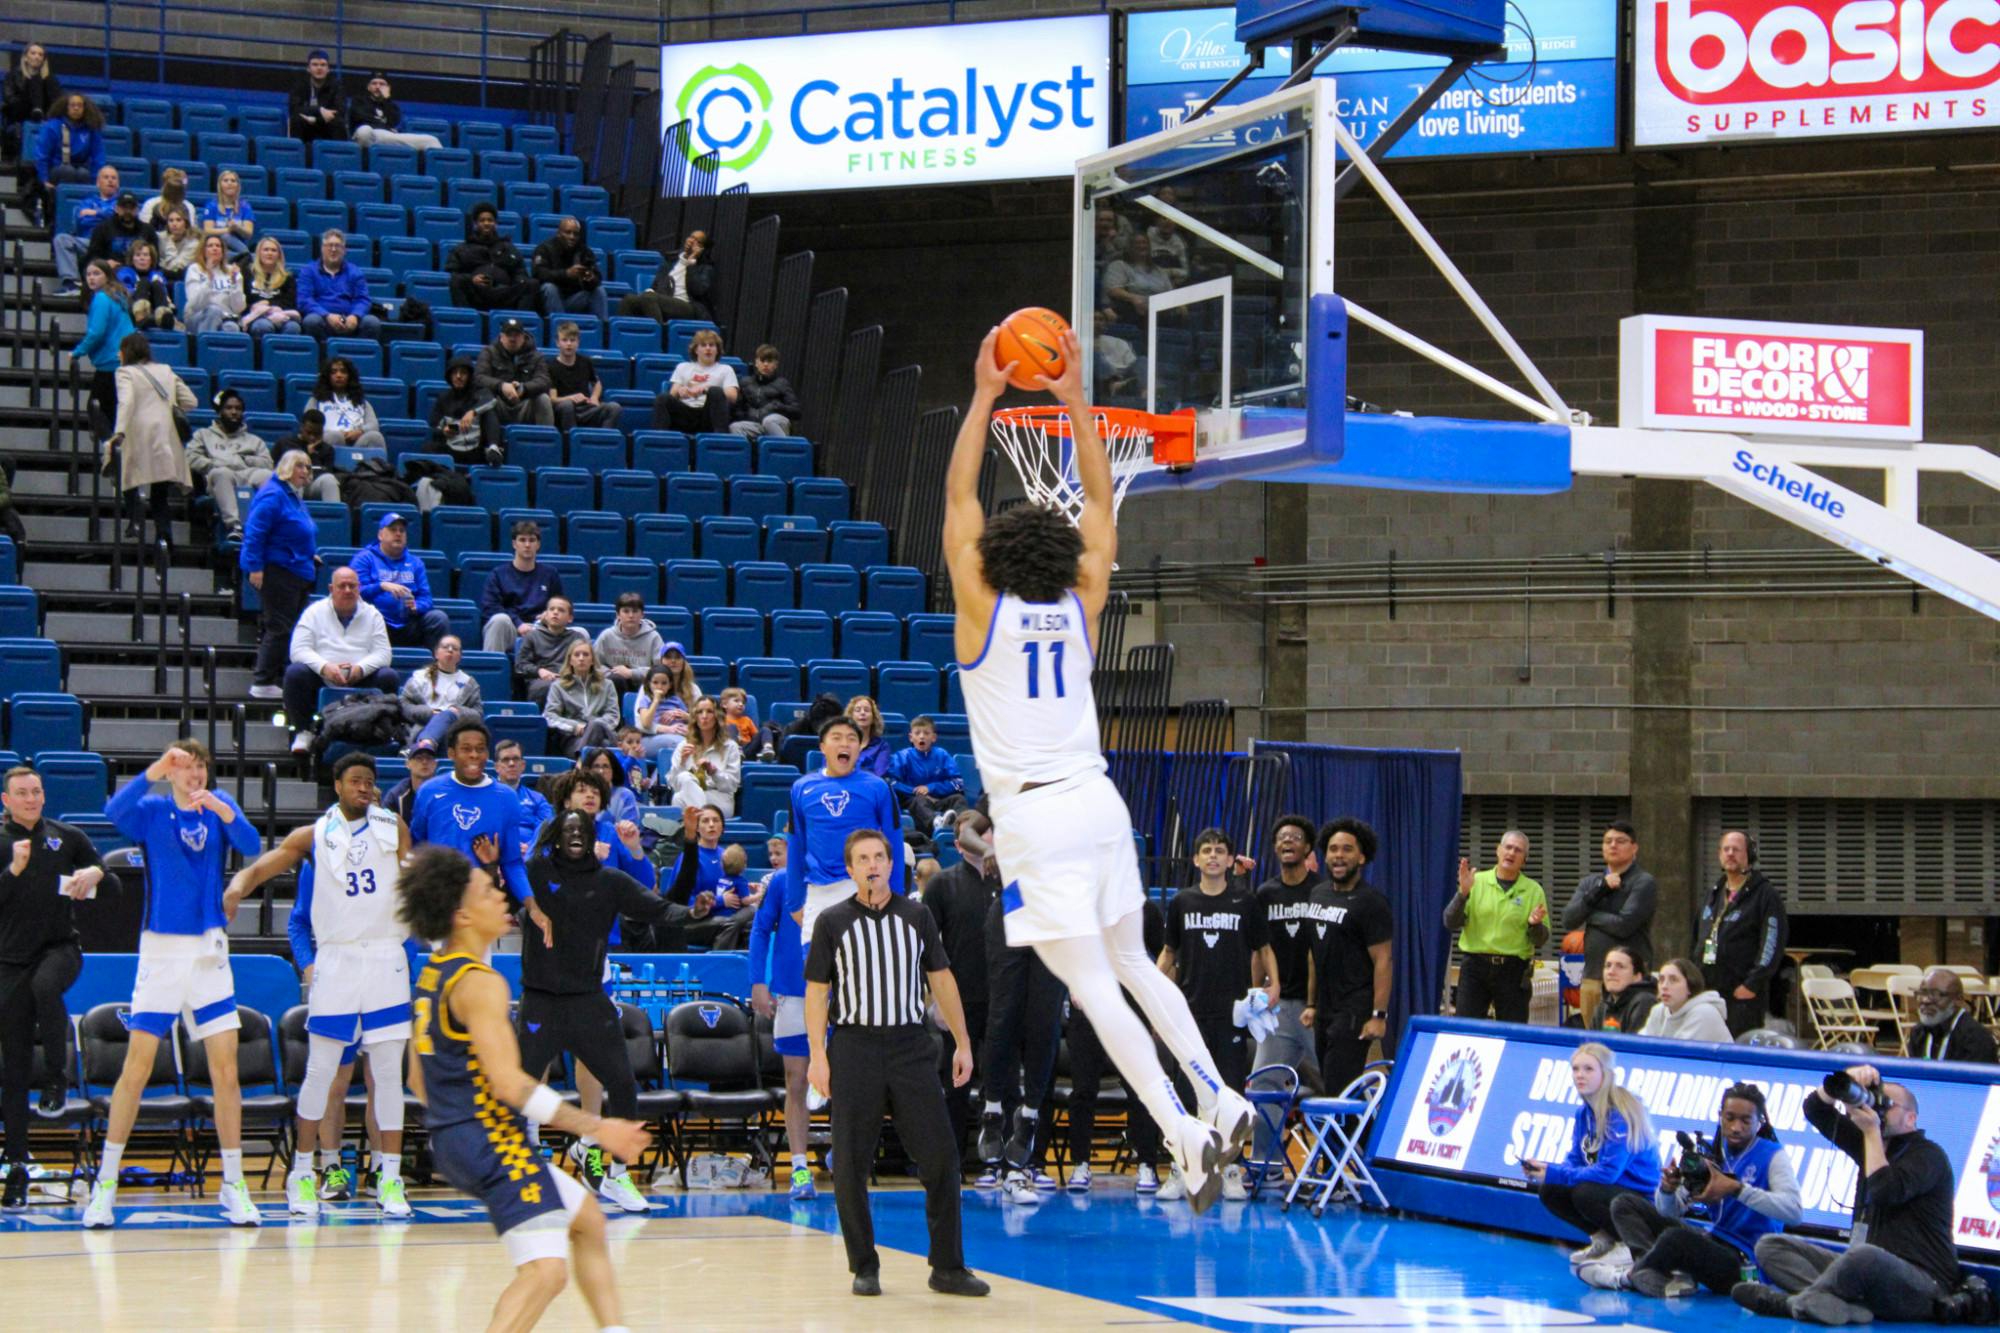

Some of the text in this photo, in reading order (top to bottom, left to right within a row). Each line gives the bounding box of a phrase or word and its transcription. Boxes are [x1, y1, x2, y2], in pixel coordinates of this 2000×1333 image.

[1667, 0, 2000, 93] basic
[790, 65, 1095, 148] Catalyst
[1489, 80, 1577, 106] students
[1418, 108, 1526, 138] love living.
[1687, 99, 1986, 133] SUPPLEMENTS
[848, 147, 978, 173] FITNESS
[1692, 337, 1815, 373] FLOOR
[1692, 366, 1815, 402] DECOR
[1692, 398, 1868, 421] TILE WOOD STONE
[1732, 449, 1846, 519] Schelde
[1022, 641, 1066, 699] 11
[346, 868, 376, 897] 33
